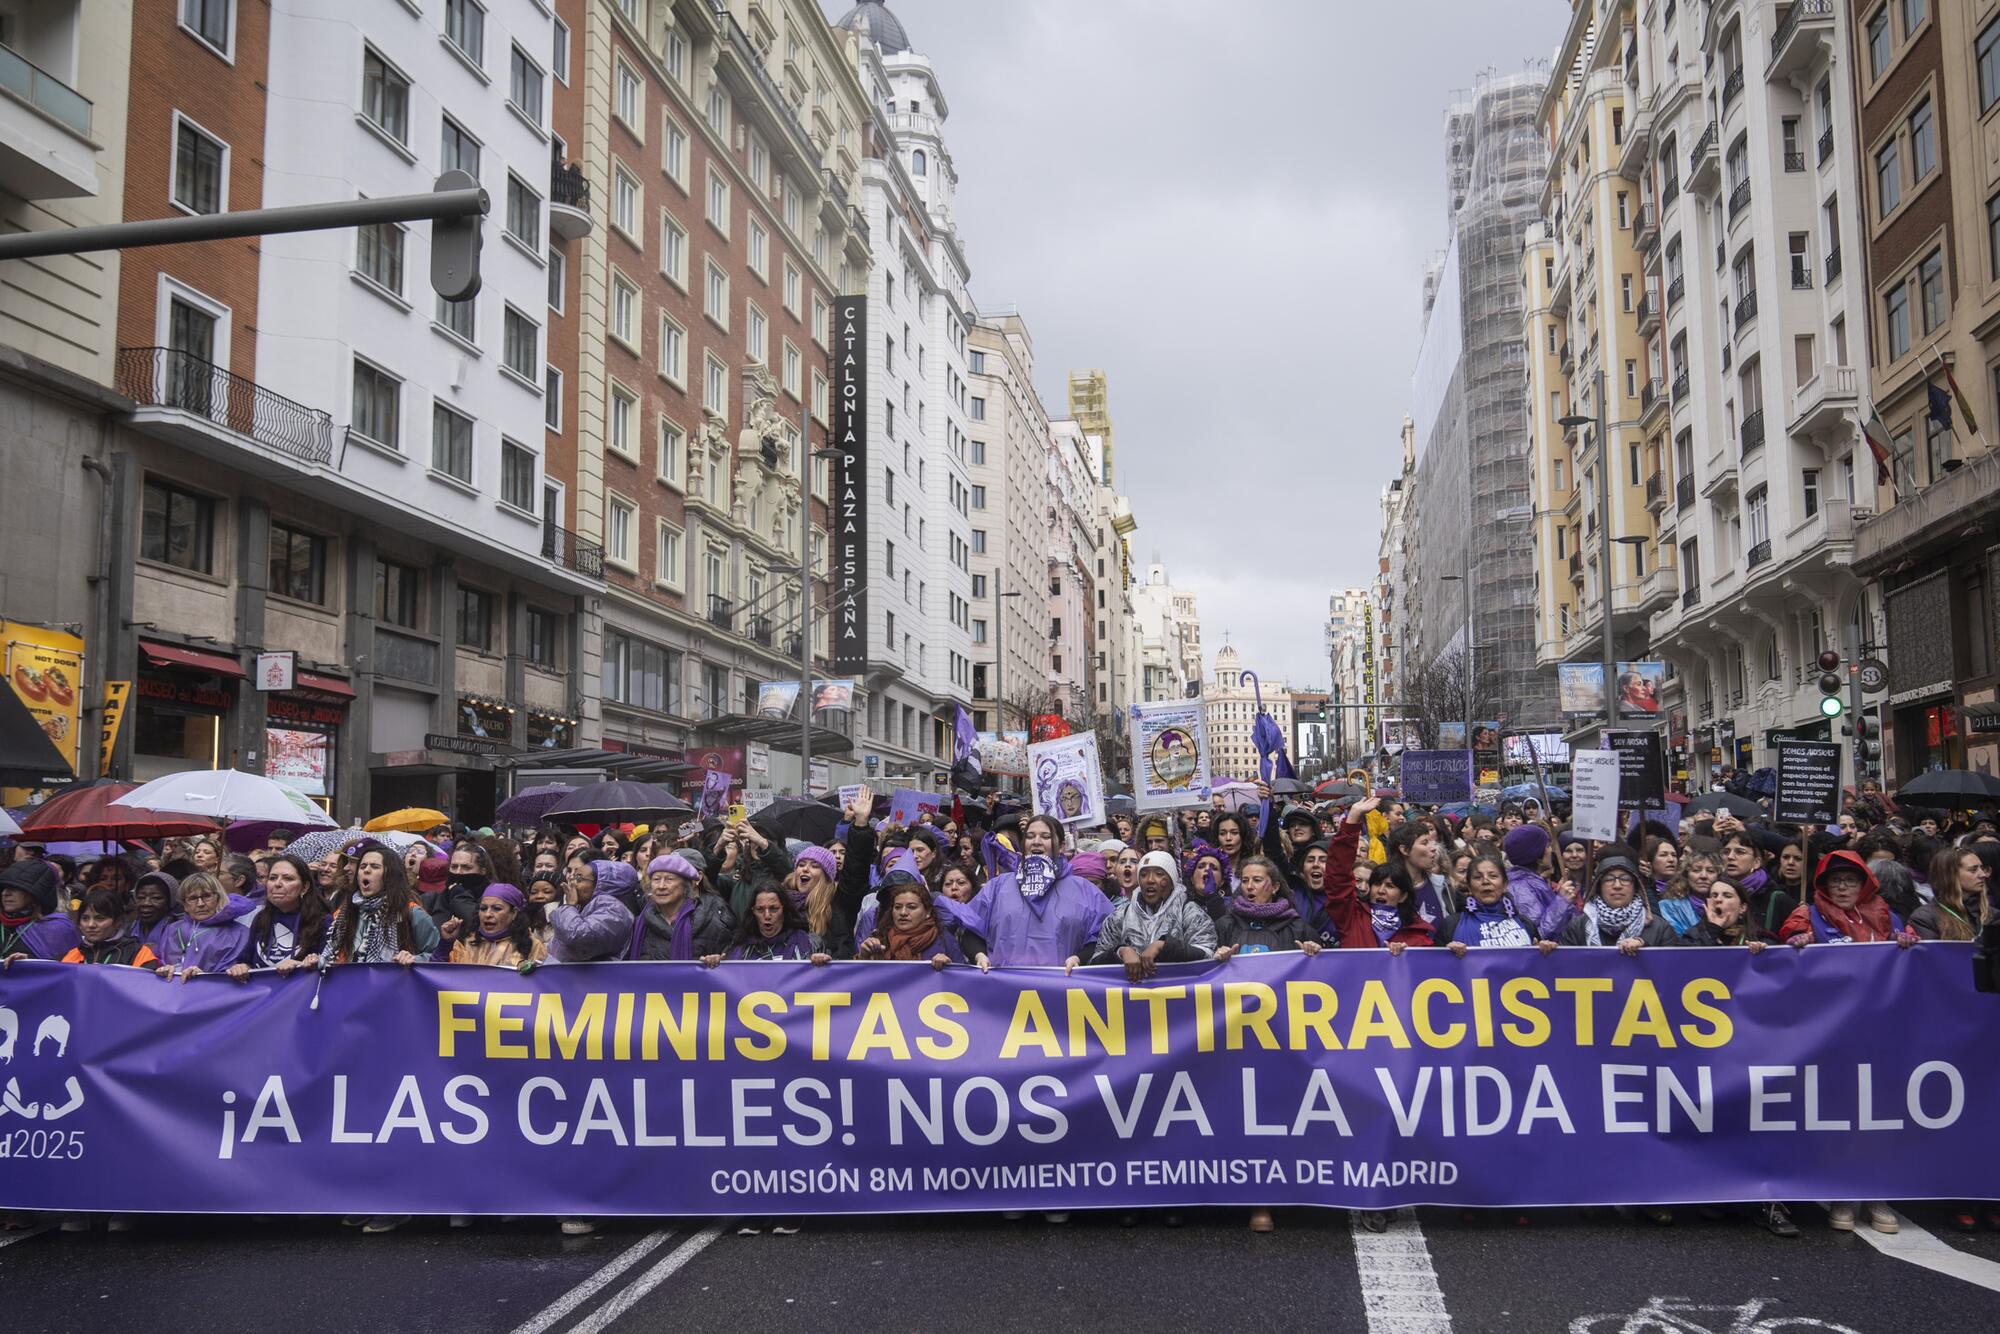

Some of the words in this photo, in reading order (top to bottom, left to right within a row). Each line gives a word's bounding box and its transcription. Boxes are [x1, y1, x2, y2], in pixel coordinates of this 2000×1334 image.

[843, 306, 857, 443] CATALONIA
[843, 454, 857, 533] PLAZA
[843, 544, 857, 639] ESPAÑA
[1364, 604, 1373, 653] HOTEL
[34, 655, 52, 663] HOT
[54, 658, 77, 668] DOGS
[1863, 670, 1880, 682] 53
[1366, 657, 1376, 743] EMPERADOR
[1972, 715, 2000, 730] OTEL
[1782, 748, 1806, 756] SOMOS
[438, 992, 968, 1060] FEMINISTAS
[1002, 978, 1732, 1056] ANTIRRACISTAS
[219, 1076, 302, 1158] ¡A
[331, 1075, 489, 1144] LAS
[518, 1077, 856, 1146] CALLES!
[888, 1076, 1068, 1145] NOS
[1094, 1072, 1213, 1137] VA
[1243, 1068, 1353, 1136] LA
[1375, 1065, 1575, 1136] VIDA
[1602, 1064, 1712, 1133] EN
[1749, 1061, 1965, 1130] ELLO
[711, 1162, 859, 1194] COMISIÓN
[870, 1167, 913, 1192] 8M
[923, 1162, 1117, 1191] MOVIMIENTO
[1127, 1160, 1286, 1186] FEMINISTA
[1296, 1160, 1335, 1185] DE
[1344, 1161, 1458, 1188] MADRID
